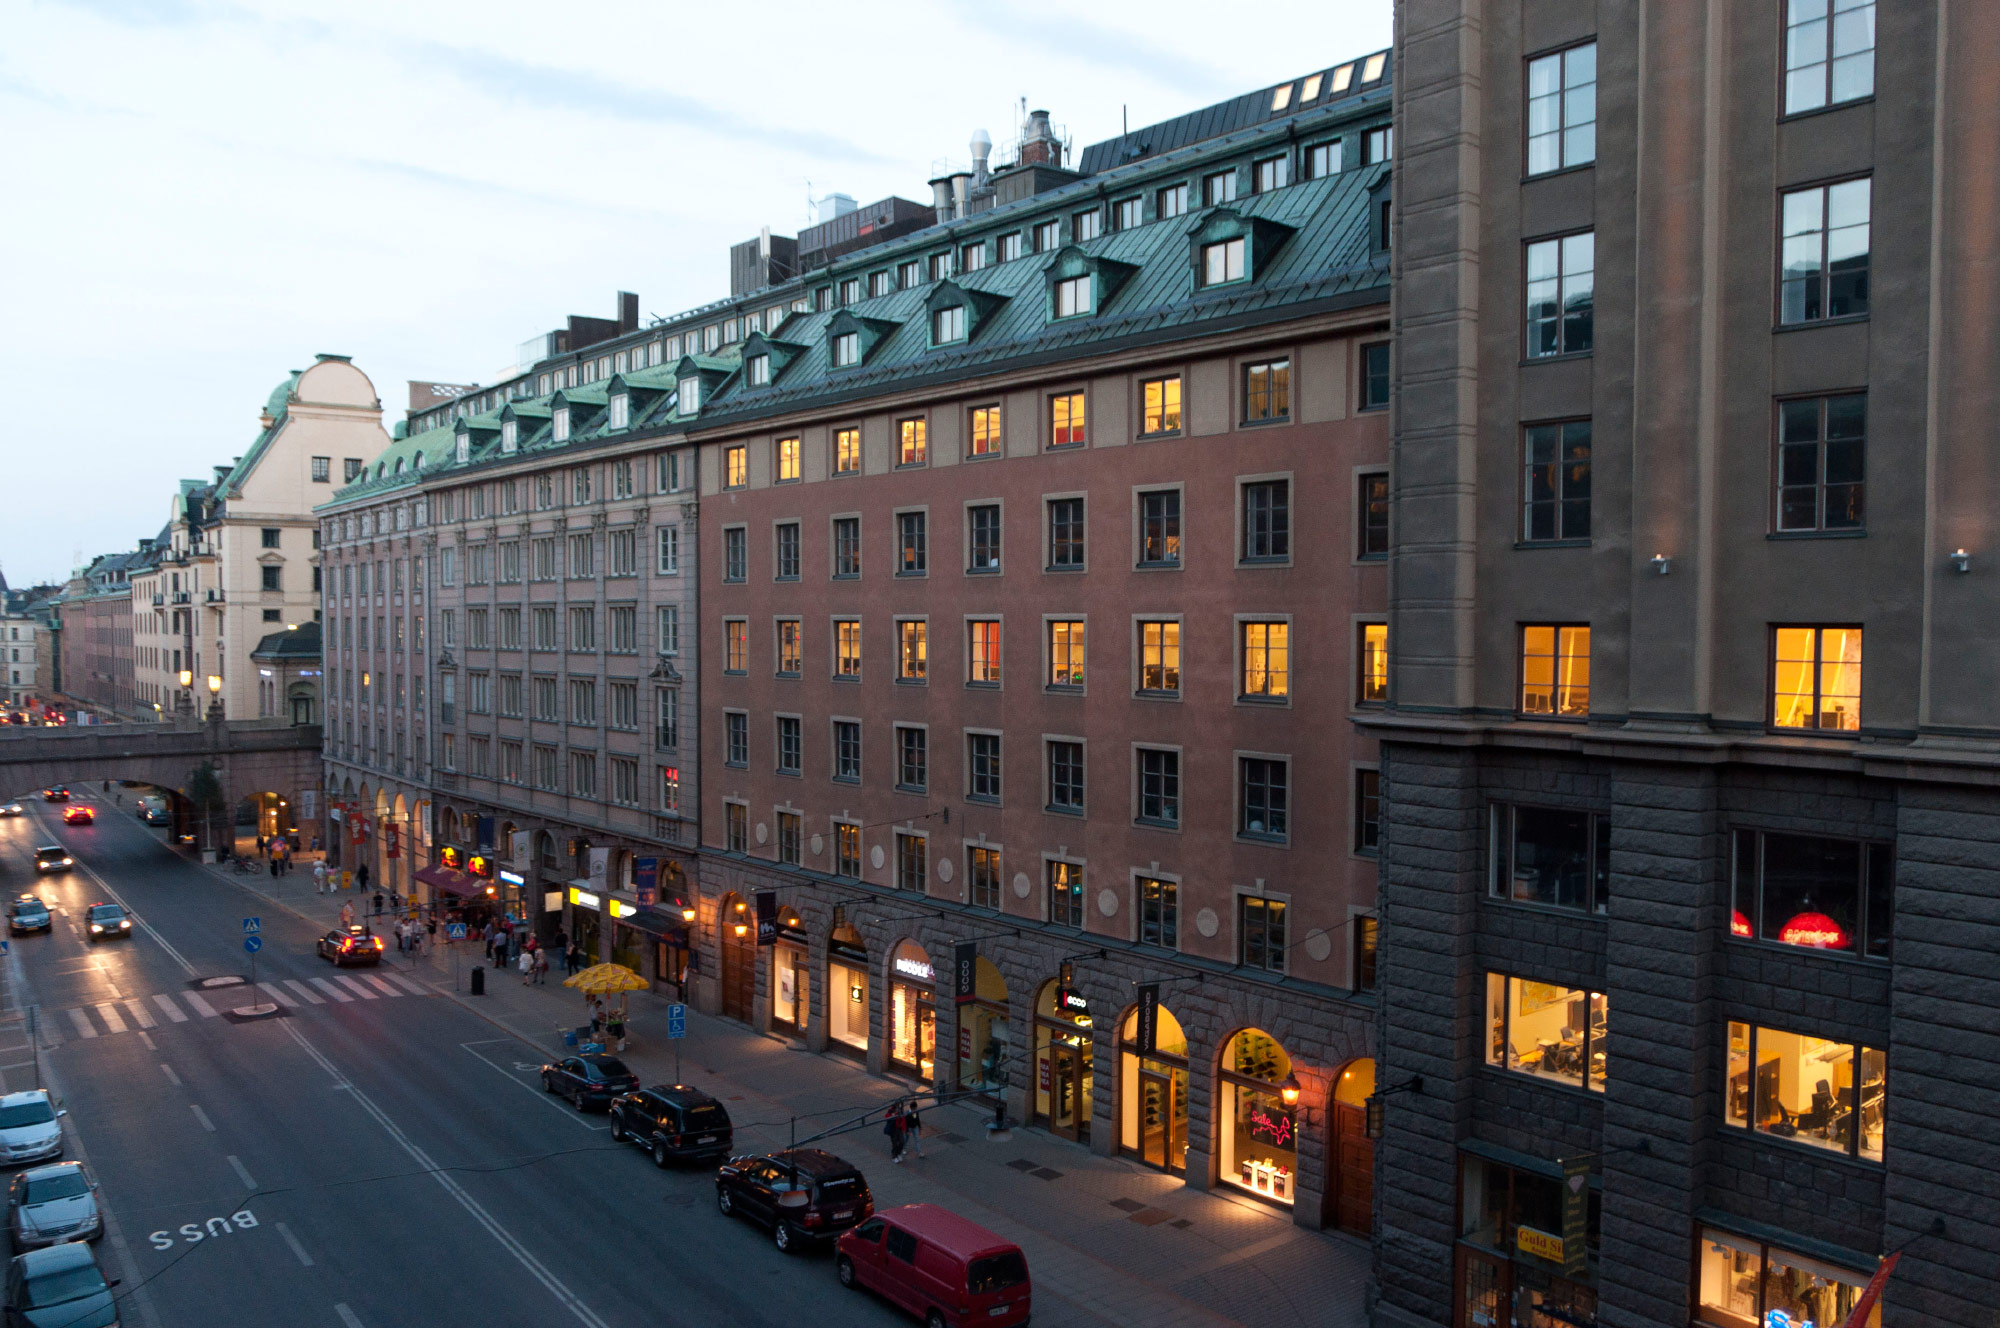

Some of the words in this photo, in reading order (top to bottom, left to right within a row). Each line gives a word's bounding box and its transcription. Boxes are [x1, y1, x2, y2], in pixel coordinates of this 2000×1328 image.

[961, 960, 970, 993] ecco
[672, 1006, 681, 1017] P
[1067, 995, 1087, 1008] ecco
[1143, 992, 1151, 1051] VAGABOND
[1251, 1110, 1271, 1126] Sale
[149, 1209, 260, 1251] BUSS
[1519, 1230, 1547, 1249] Guld
[1550, 1240, 1563, 1254] Si
